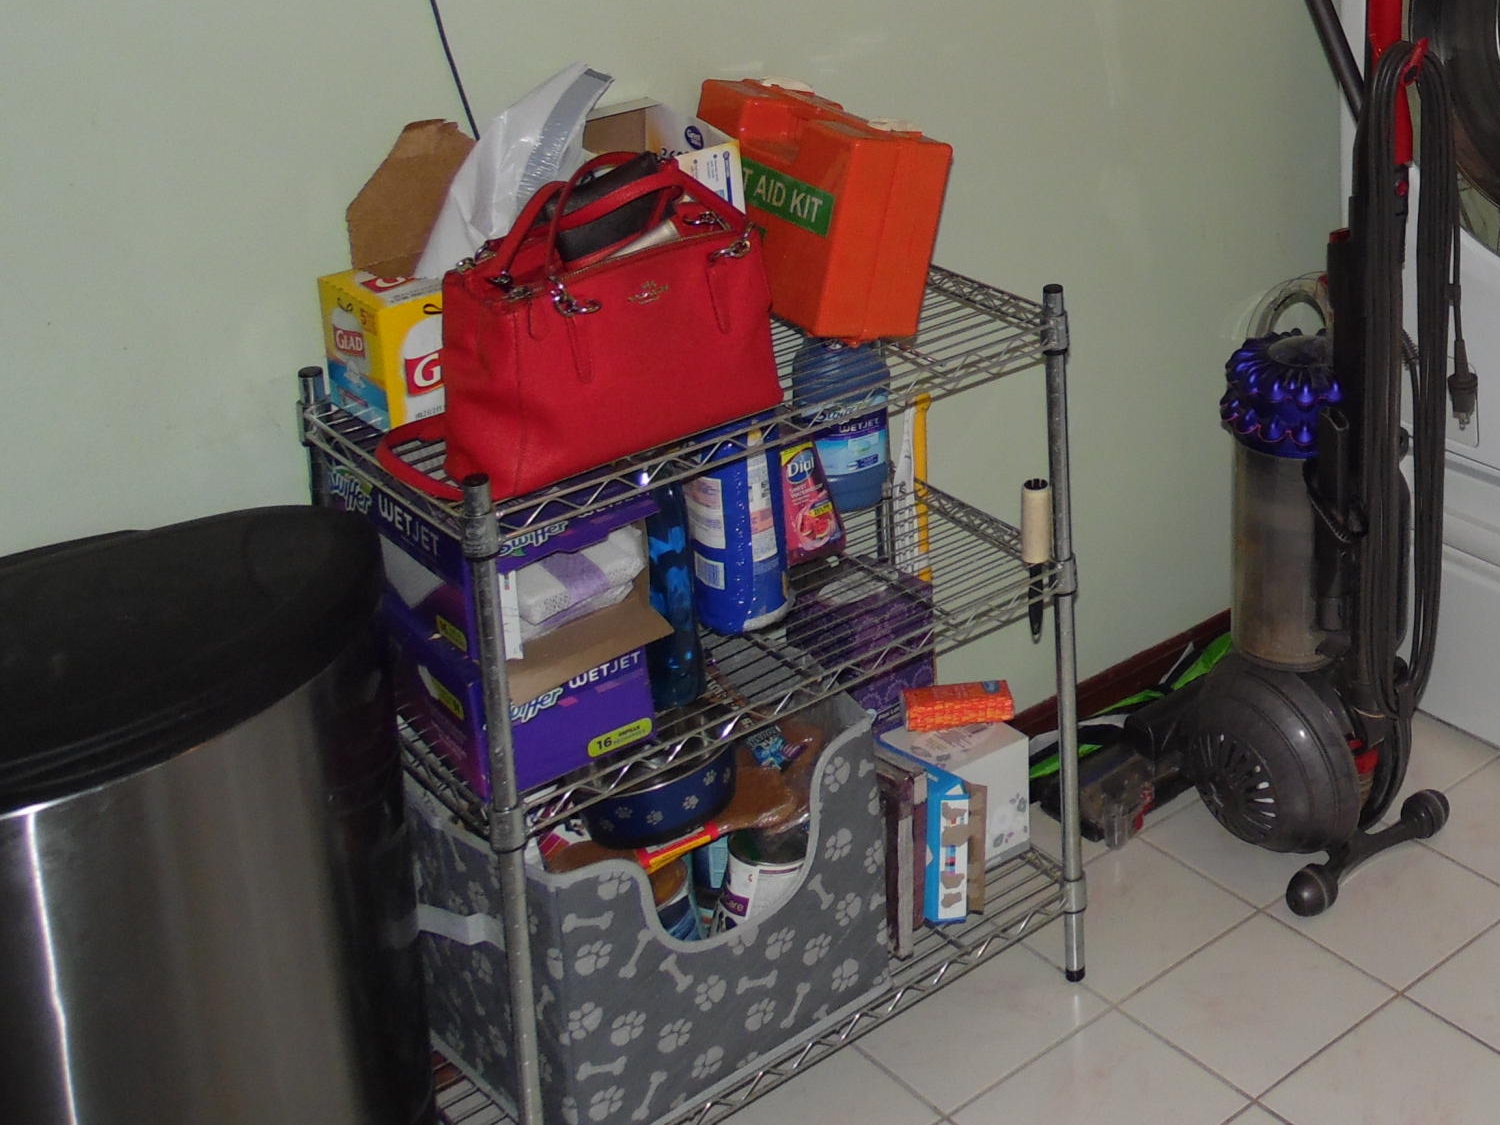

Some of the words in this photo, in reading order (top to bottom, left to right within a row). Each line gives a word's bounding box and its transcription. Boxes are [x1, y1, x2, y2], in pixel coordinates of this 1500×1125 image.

[742, 168, 753, 193] T
[755, 175, 786, 208] AID
[790, 188, 824, 223] KIT
[335, 329, 364, 352] GLAD
[787, 455, 815, 478] Dial
[330, 472, 373, 515] Swiffer
[499, 519, 569, 558] Swiffer
[596, 736, 613, 751] 16
